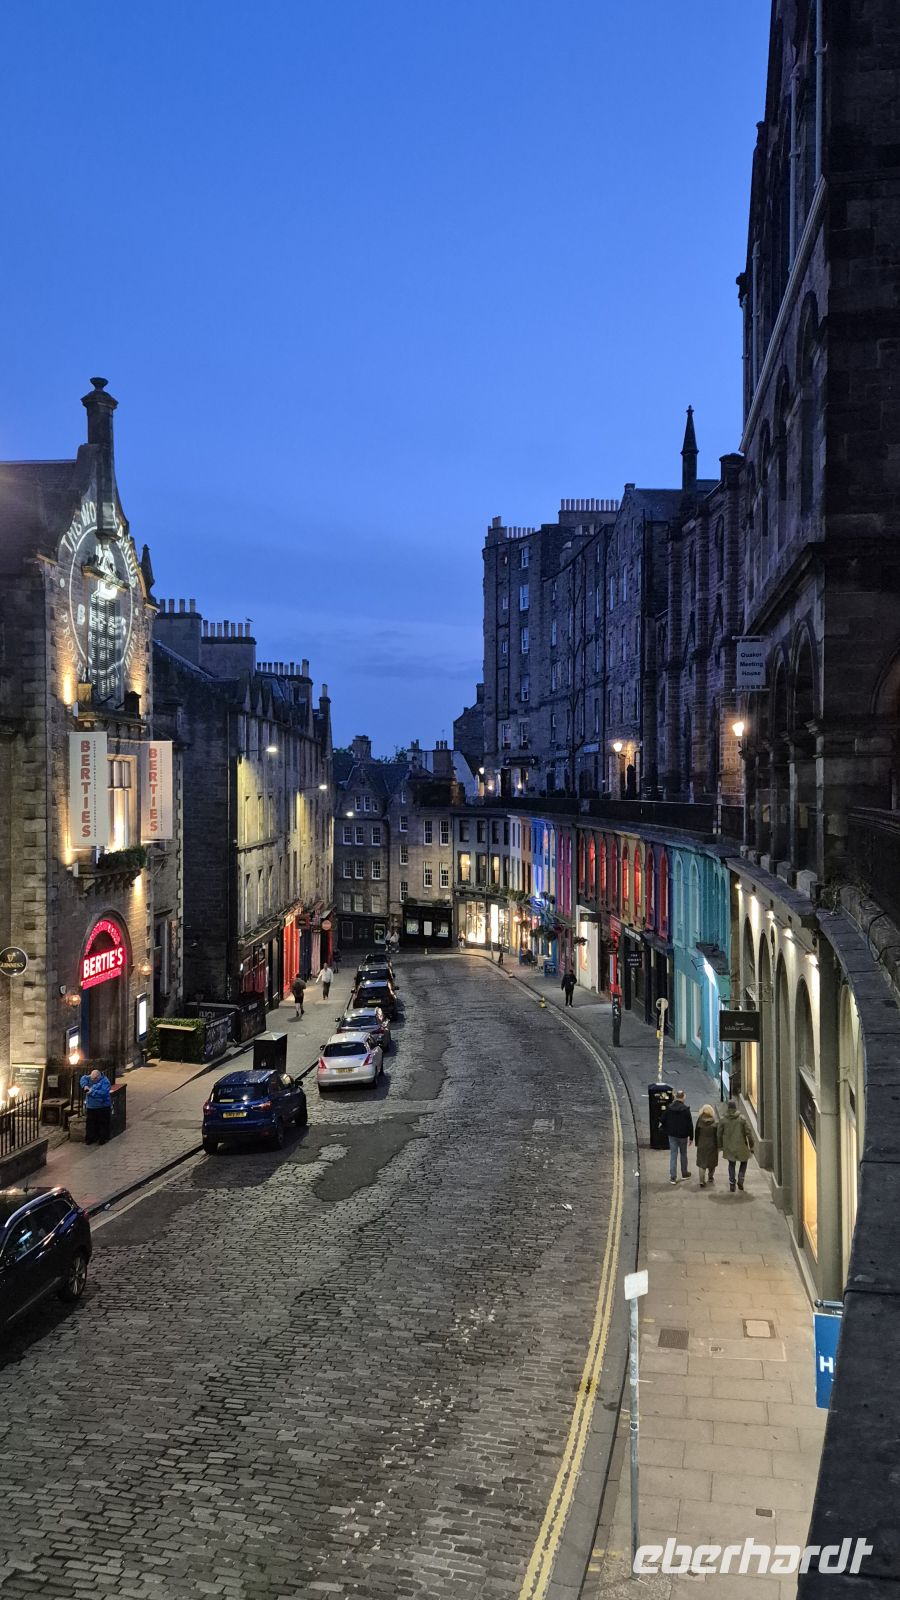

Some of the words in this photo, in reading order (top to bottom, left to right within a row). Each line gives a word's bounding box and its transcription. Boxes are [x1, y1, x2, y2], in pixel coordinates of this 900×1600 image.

[80, 740, 91, 838] BERTIES
[148, 747, 158, 832] BERTIES
[83, 947, 123, 979] BERTIE'S
[819, 1355, 834, 1374] H
